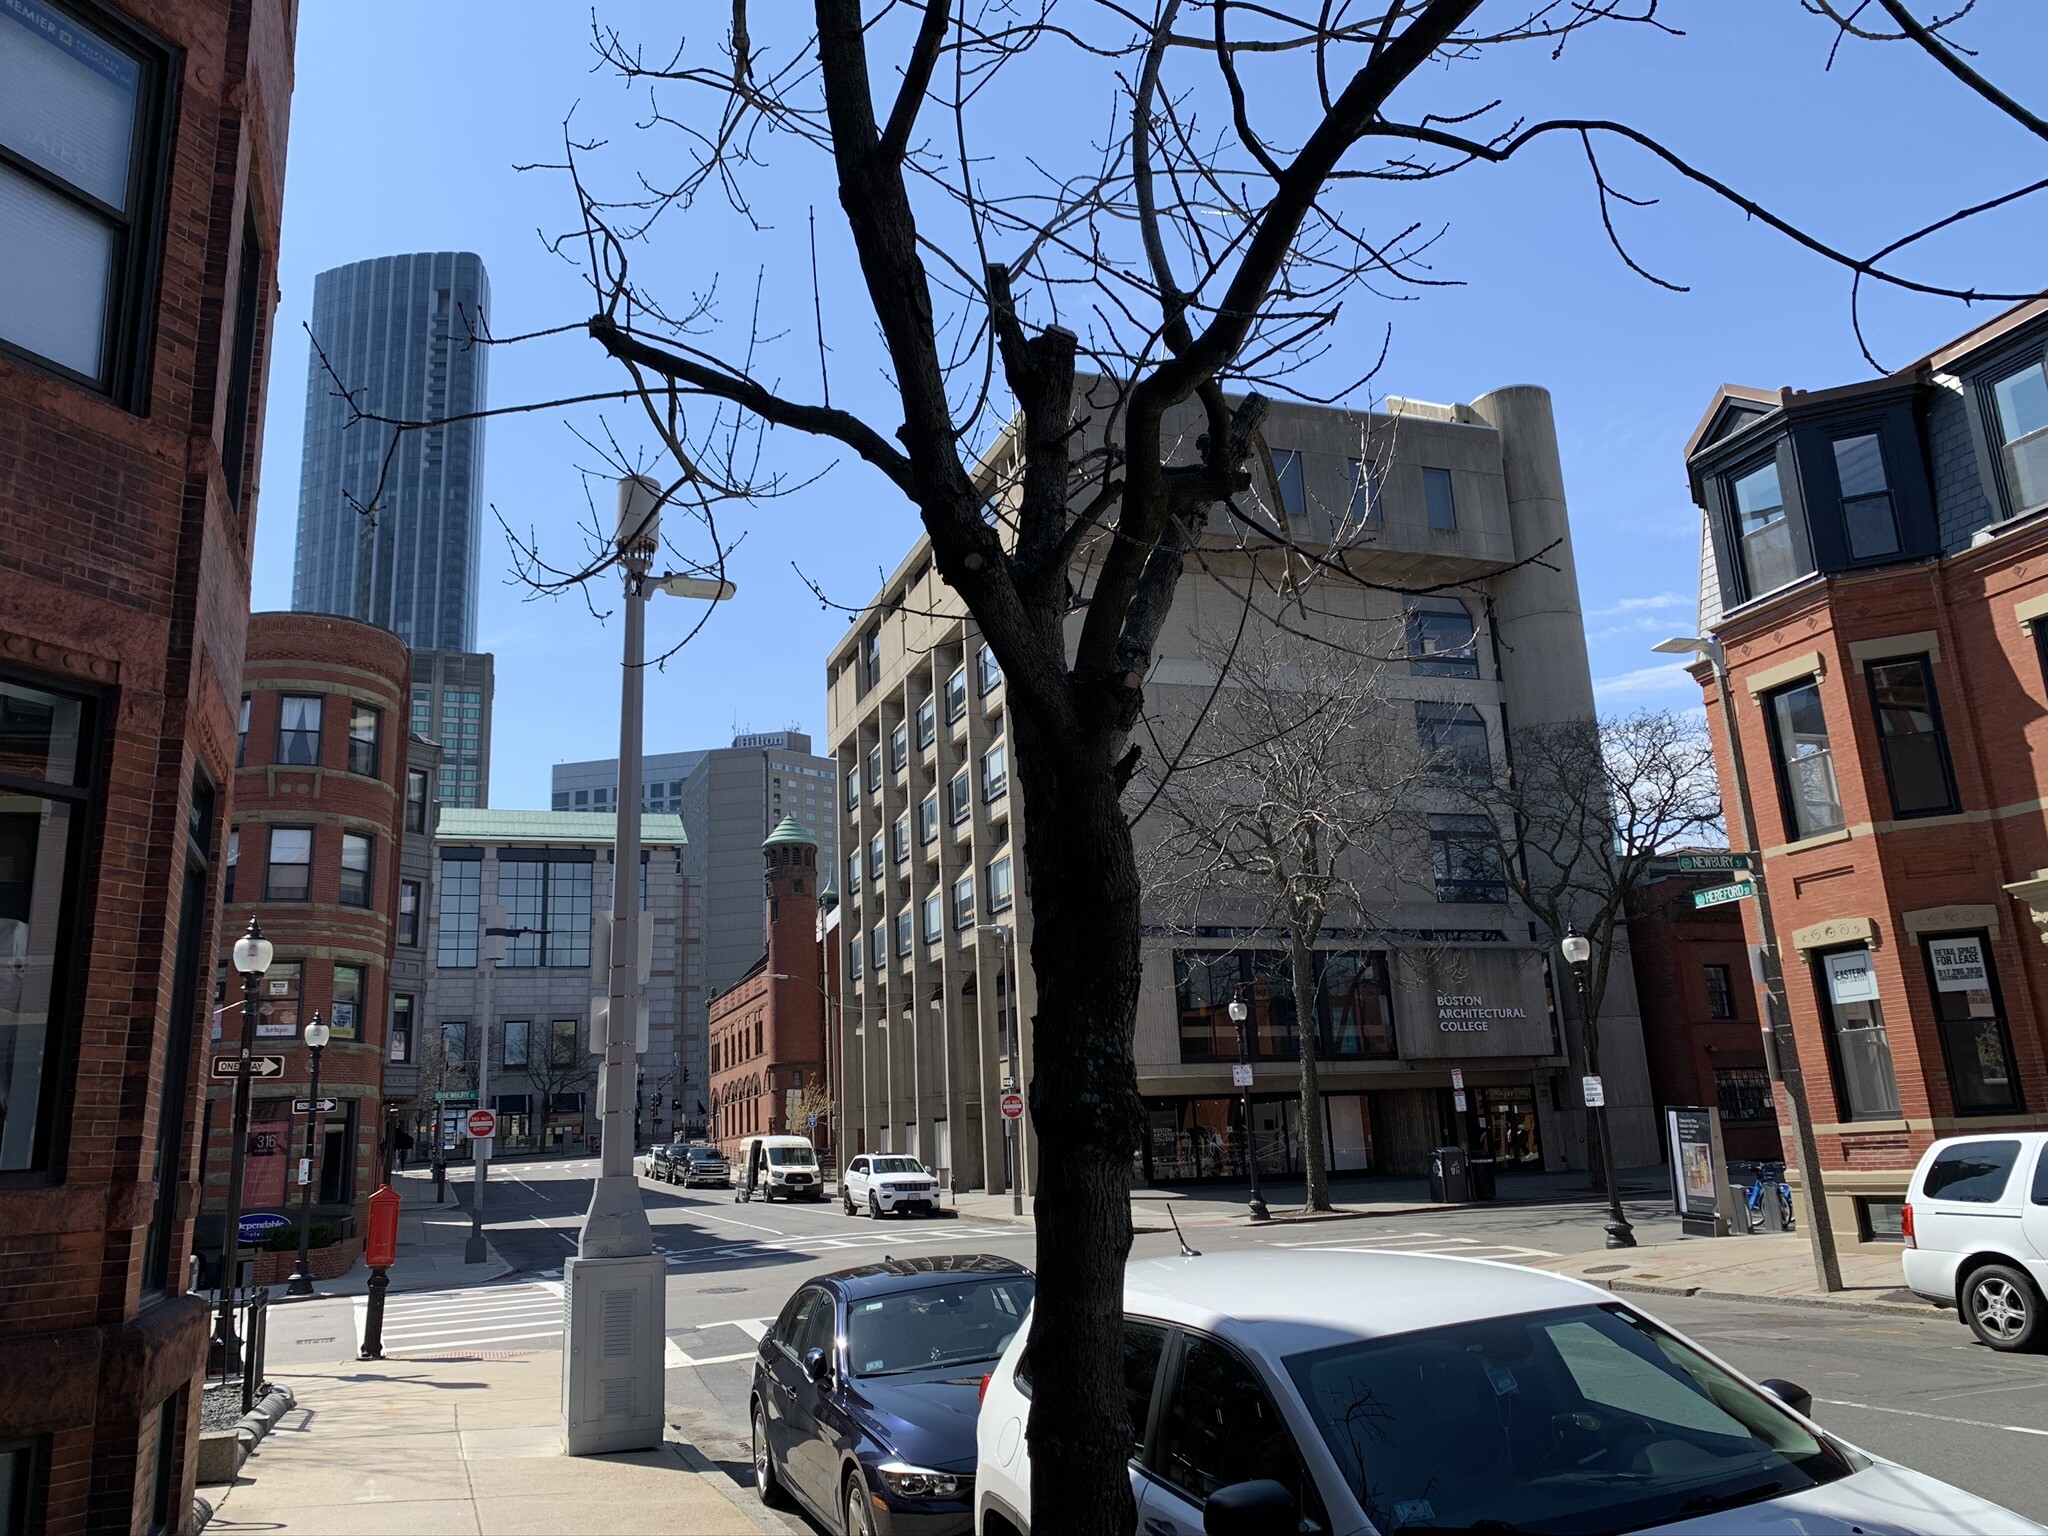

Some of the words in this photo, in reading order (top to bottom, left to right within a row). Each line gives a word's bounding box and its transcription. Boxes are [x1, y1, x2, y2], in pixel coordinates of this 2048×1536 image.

[5, 0, 56, 35] REMIER
[740, 736, 783, 748] Hilton
[1692, 856, 1734, 868] NEWBURY
[1704, 885, 1744, 904] HEREFORD
[1934, 948, 1957, 957] RETAIL
[1957, 946, 1978, 955] SPACE
[1936, 956, 1953, 966] FOR
[1953, 953, 1980, 965] LEASE
[1834, 967, 1867, 981] EASTERN
[1437, 996, 1483, 1007] BOSTON
[1438, 1008, 1527, 1019] ARCHITECTURAL
[1440, 1021, 1489, 1032] COLLEGE
[220, 1062, 240, 1071] ONE
[443, 1091, 470, 1099] NEWBURY
[256, 1135, 277, 1148] 316
